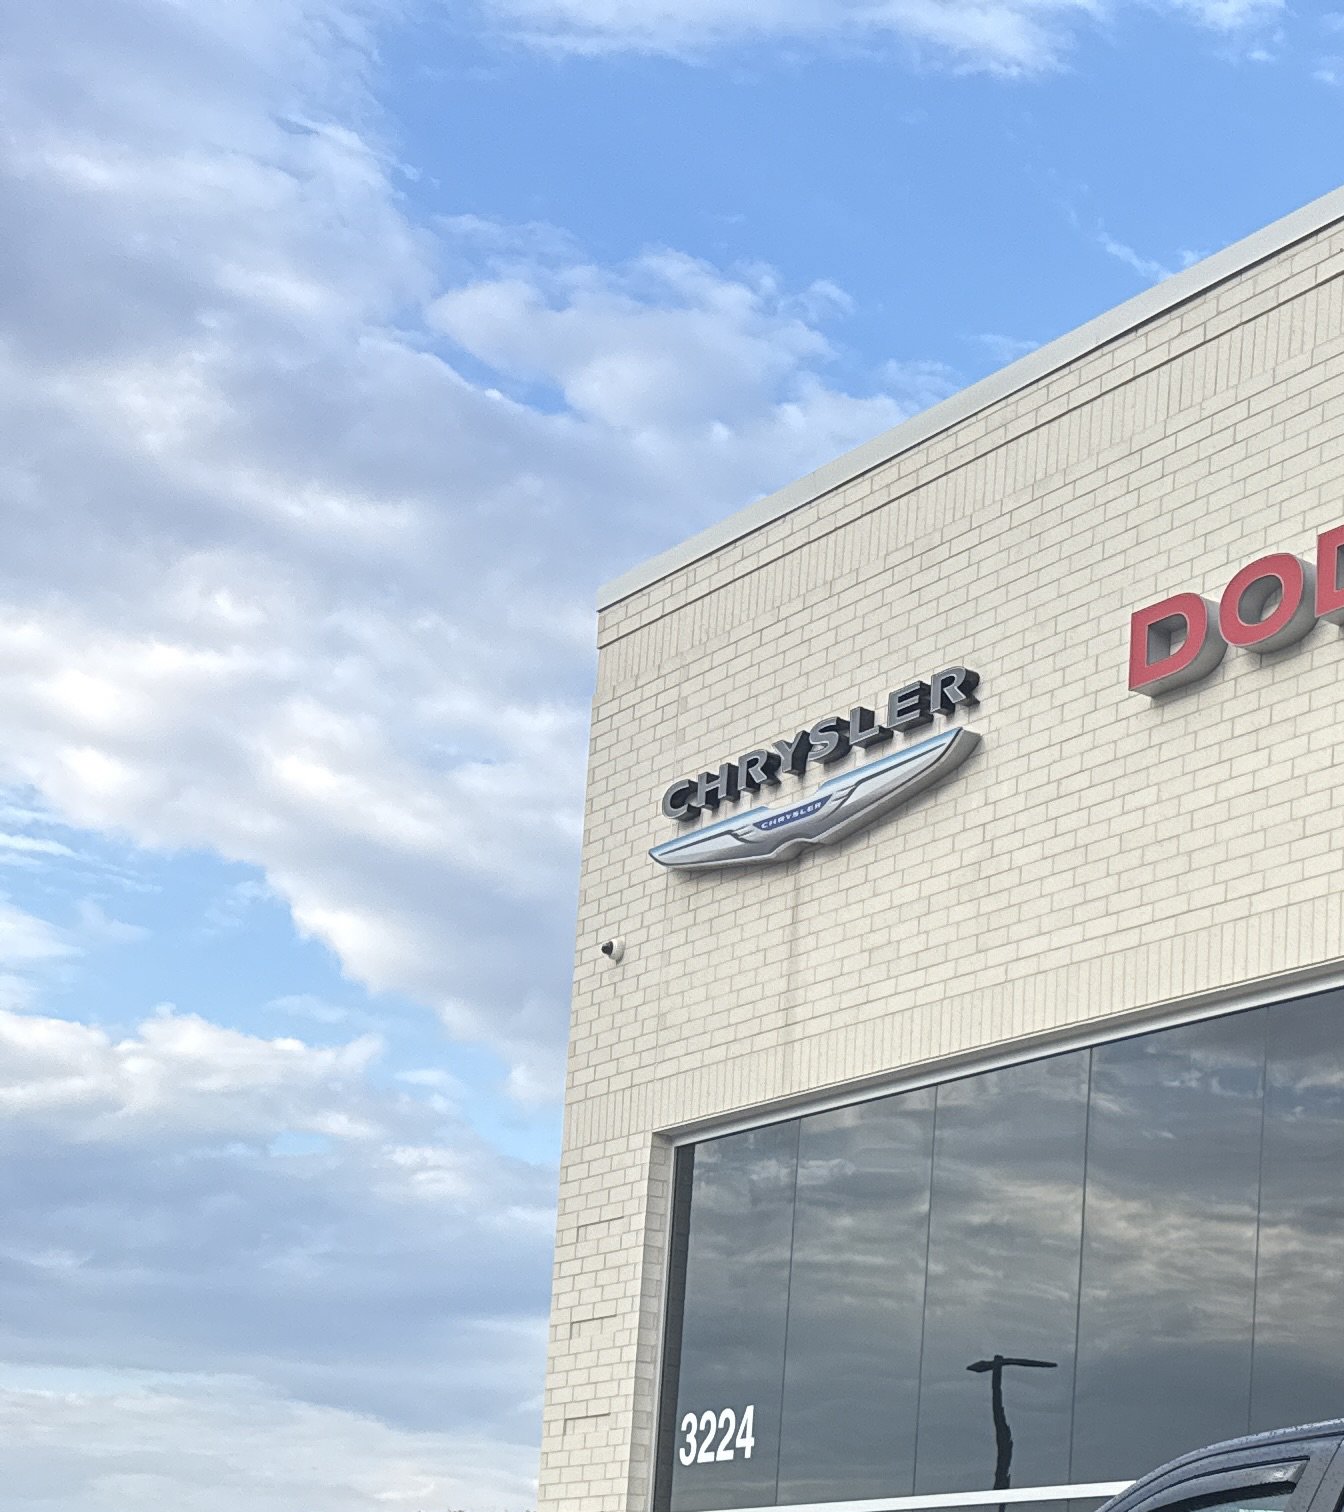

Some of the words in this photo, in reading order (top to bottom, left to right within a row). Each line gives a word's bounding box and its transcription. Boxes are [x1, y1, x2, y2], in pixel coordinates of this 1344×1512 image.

[662, 666, 980, 821] CHRYSLER
[760, 801, 822, 829] CHRYSLER
[679, 1404, 755, 1466] 3224
